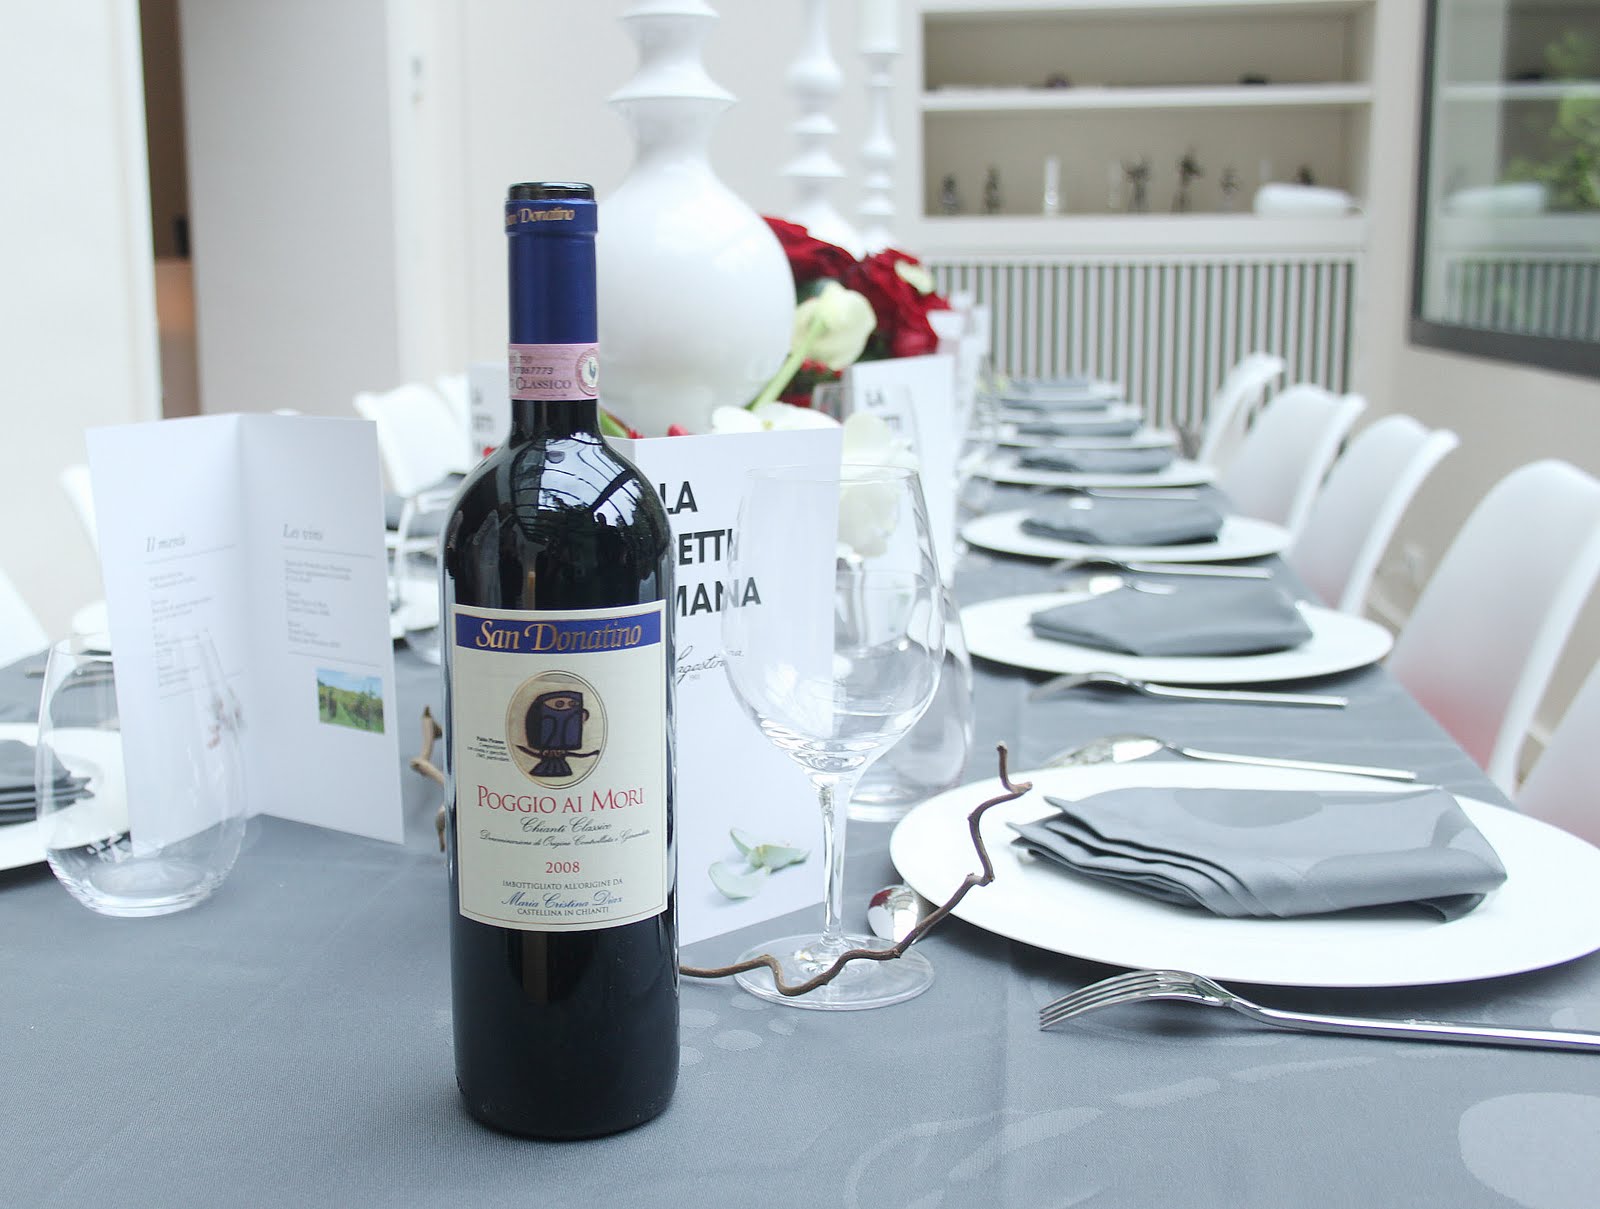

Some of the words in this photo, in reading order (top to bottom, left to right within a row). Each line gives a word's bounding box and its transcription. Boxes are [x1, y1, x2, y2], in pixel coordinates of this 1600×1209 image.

[516, 377, 572, 390] CLASSICO
[659, 481, 698, 515] LA
[678, 528, 739, 566] ETTI
[475, 620, 520, 650] San
[523, 620, 642, 651] Donatino
[477, 785, 557, 814] POGGIO
[562, 796, 582, 813] AI
[590, 787, 645, 812] MORI
[520, 816, 567, 833] Chianti
[569, 816, 612, 833] Classico
[542, 835, 571, 849] Origine
[545, 861, 581, 874] 2008
[502, 880, 562, 890] IMBOTTIGLIATO
[563, 879, 611, 890] ALL'ORIGINE
[501, 891, 539, 907] Maria
[542, 892, 589, 909] Cristina
[517, 908, 562, 917] CASTELLINA
[575, 907, 609, 916] CHIANTI
